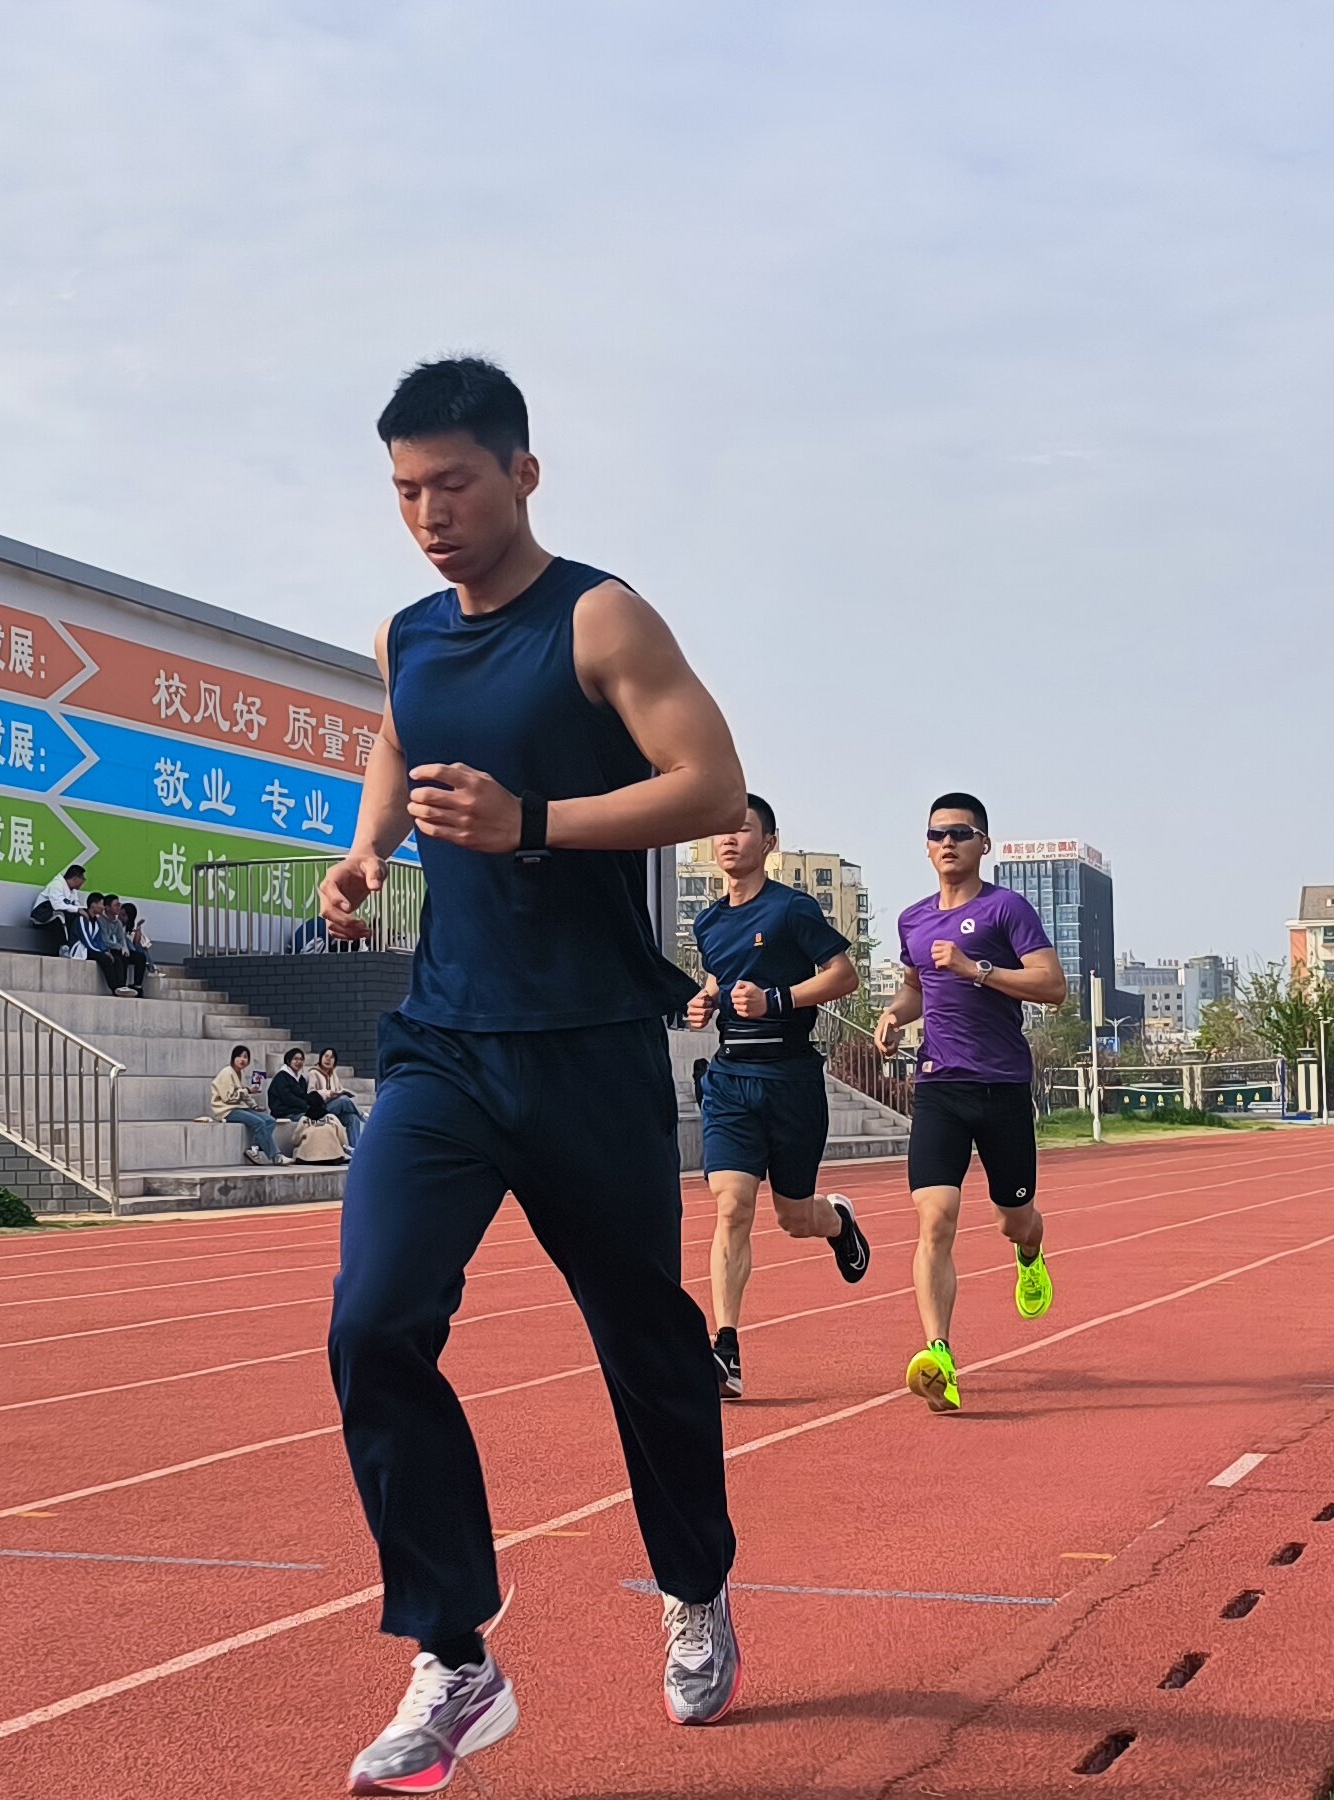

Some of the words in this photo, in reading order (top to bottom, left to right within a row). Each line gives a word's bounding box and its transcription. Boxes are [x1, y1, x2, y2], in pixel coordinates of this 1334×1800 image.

[152, 669, 267, 741] 校风好
[153, 756, 236, 817] 敬业
[261, 778, 334, 835] 专业
[153, 842, 235, 901] 成长
